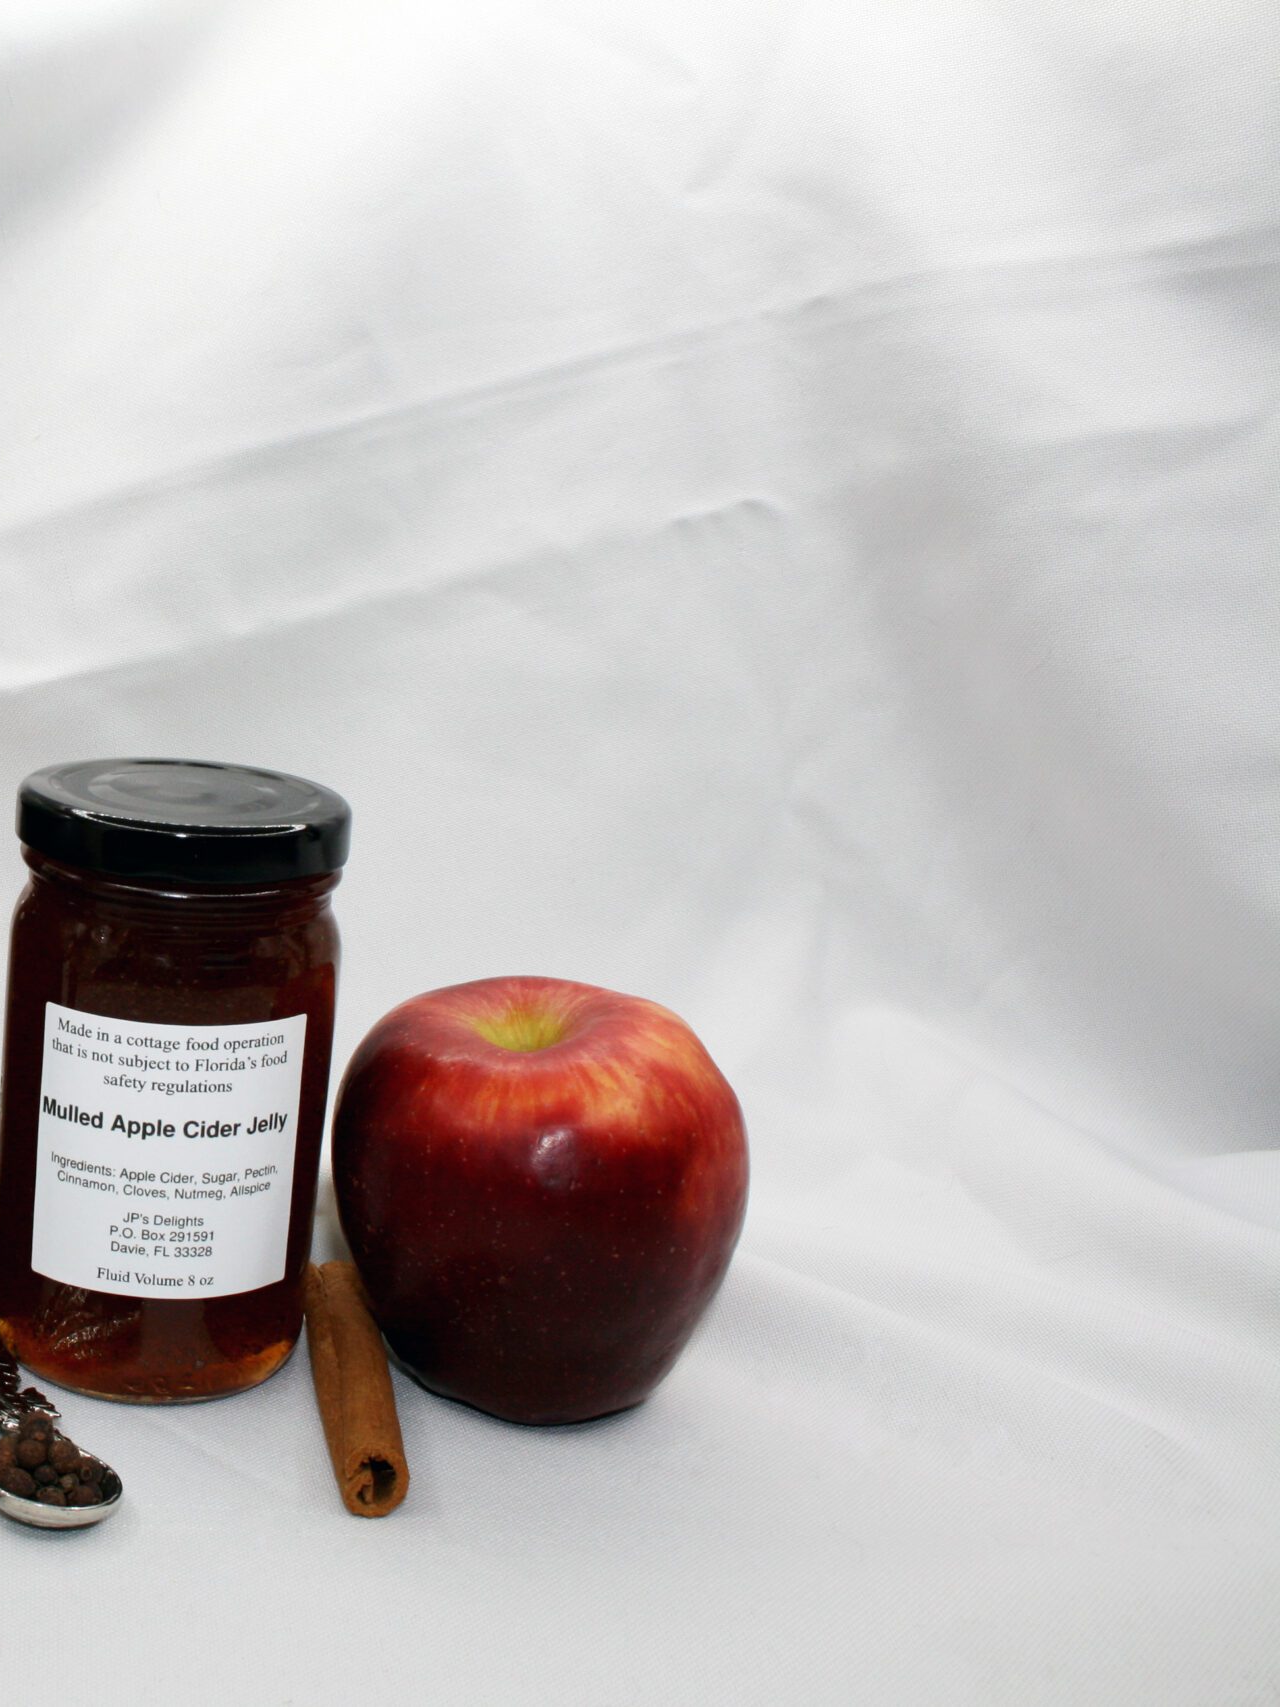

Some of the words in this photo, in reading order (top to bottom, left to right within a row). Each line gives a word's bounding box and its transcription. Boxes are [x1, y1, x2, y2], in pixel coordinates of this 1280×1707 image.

[58, 1017, 92, 1038] Made
[97, 1027, 109, 1042] in
[114, 1035, 122, 1044] a
[126, 1037, 180, 1053] cottage
[186, 1037, 219, 1051] food
[223, 1033, 284, 1053] operation
[52, 1037, 73, 1055] that
[77, 1048, 87, 1058] is
[92, 1051, 113, 1064] not
[118, 1054, 170, 1072] subject
[175, 1061, 190, 1071] to
[261, 1050, 288, 1068] food
[103, 1074, 147, 1093] safety
[151, 1080, 232, 1096] regulations
[42, 1095, 104, 1129] Mulled
[110, 1114, 176, 1140] Apple
[183, 1120, 242, 1139] Cider
[246, 1112, 288, 1135] Jelly
[51, 1151, 115, 1178] Ingredients:
[119, 1168, 156, 1183] Apple
[160, 1172, 197, 1185] Cider,
[202, 1172, 240, 1185] Sugar,
[244, 1165, 278, 1180] Pectin,
[57, 1171, 118, 1194] Cinnamon,
[123, 1184, 169, 1200] Cloves,
[174, 1188, 226, 1201] Nutmeg,
[230, 1181, 271, 1197] Allspice
[110, 1225, 136, 1239] P.O.
[141, 1229, 165, 1241] Box
[169, 1231, 214, 1243] 291591
[153, 1215, 204, 1229] Delights
[111, 1241, 149, 1257] Davie,
[154, 1245, 170, 1257] FL
[174, 1246, 213, 1258] 33328
[97, 1267, 130, 1283] Fluid
[134, 1272, 184, 1287] Volume
[188, 1275, 195, 1286] 8
[199, 1277, 214, 1286] oz
